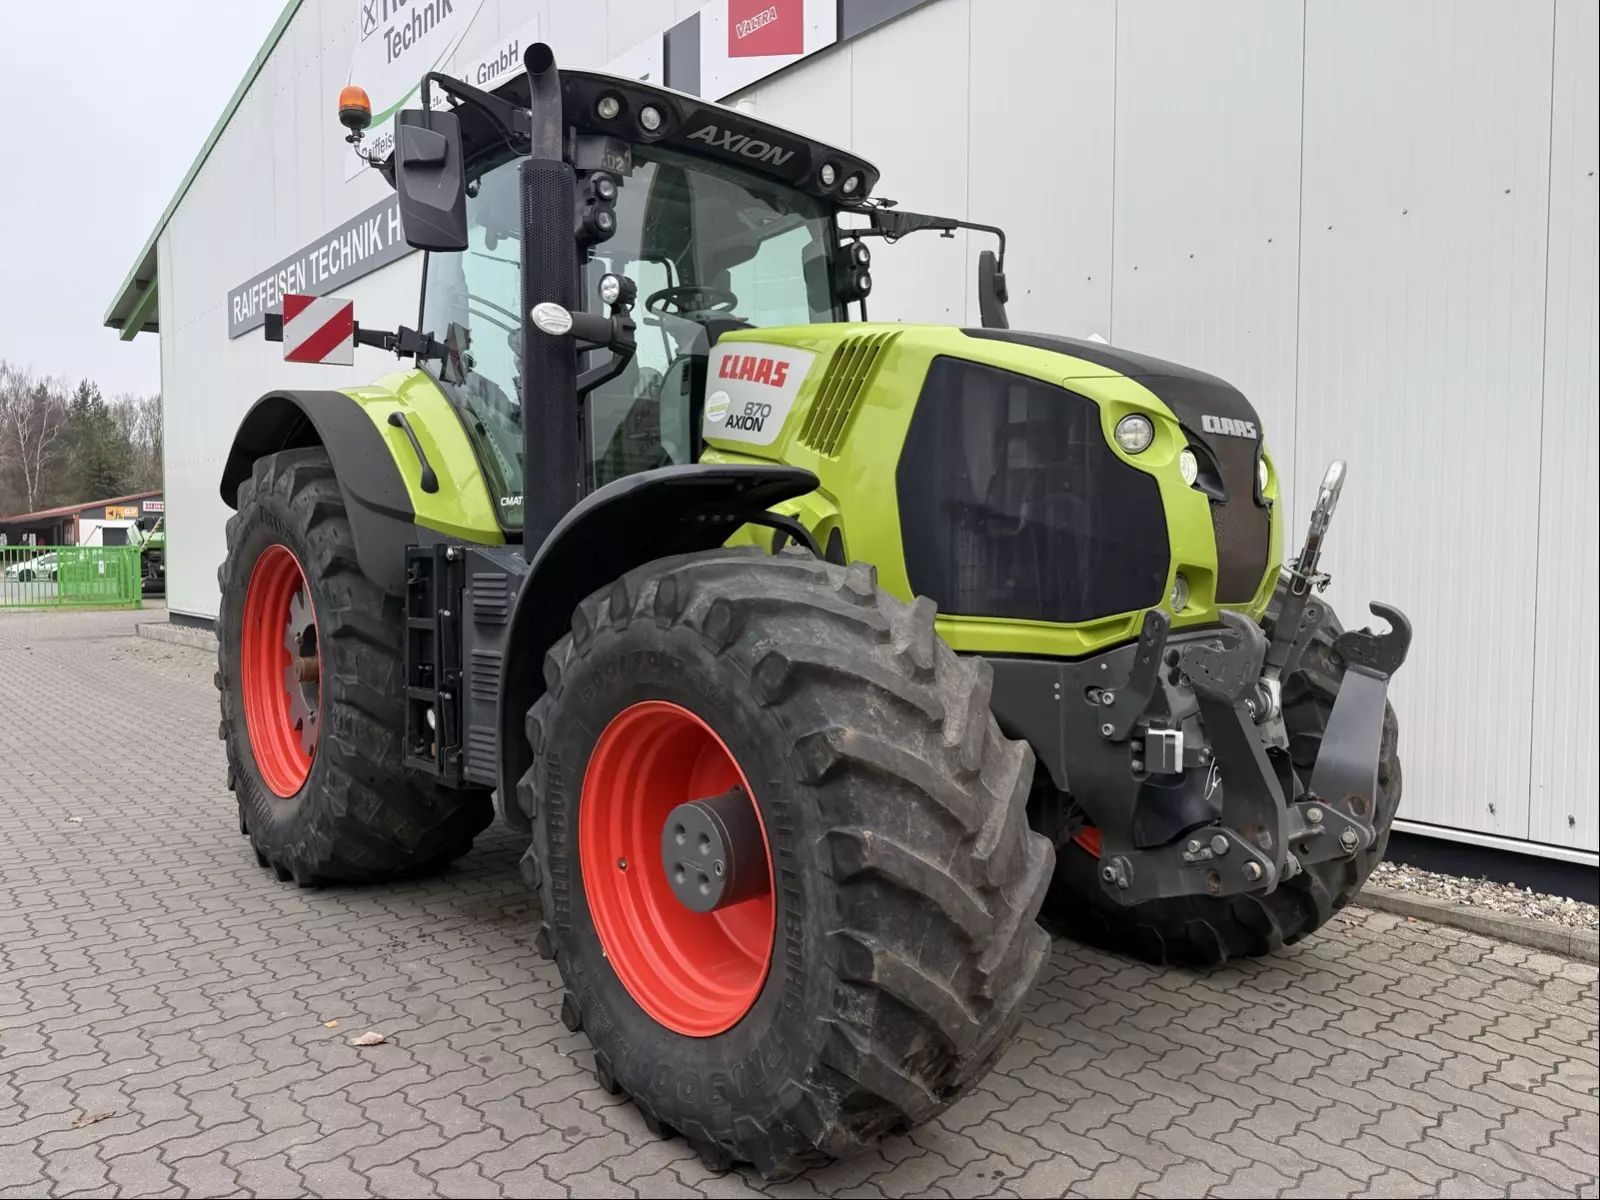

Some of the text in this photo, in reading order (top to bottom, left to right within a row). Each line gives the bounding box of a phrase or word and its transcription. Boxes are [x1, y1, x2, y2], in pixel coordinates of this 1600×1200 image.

[735, 6, 778, 39] VALTRA
[477, 40, 519, 85] GmbH
[687, 125, 794, 166] AXION
[233, 258, 306, 325] RAIFFEISEN
[309, 213, 383, 285] TECHNIK
[719, 355, 790, 388] CLAAS
[725, 414, 764, 432] AXION
[744, 402, 772, 418] 870
[1201, 414, 1257, 439] CLAAS
[500, 496, 524, 506] CMAT
